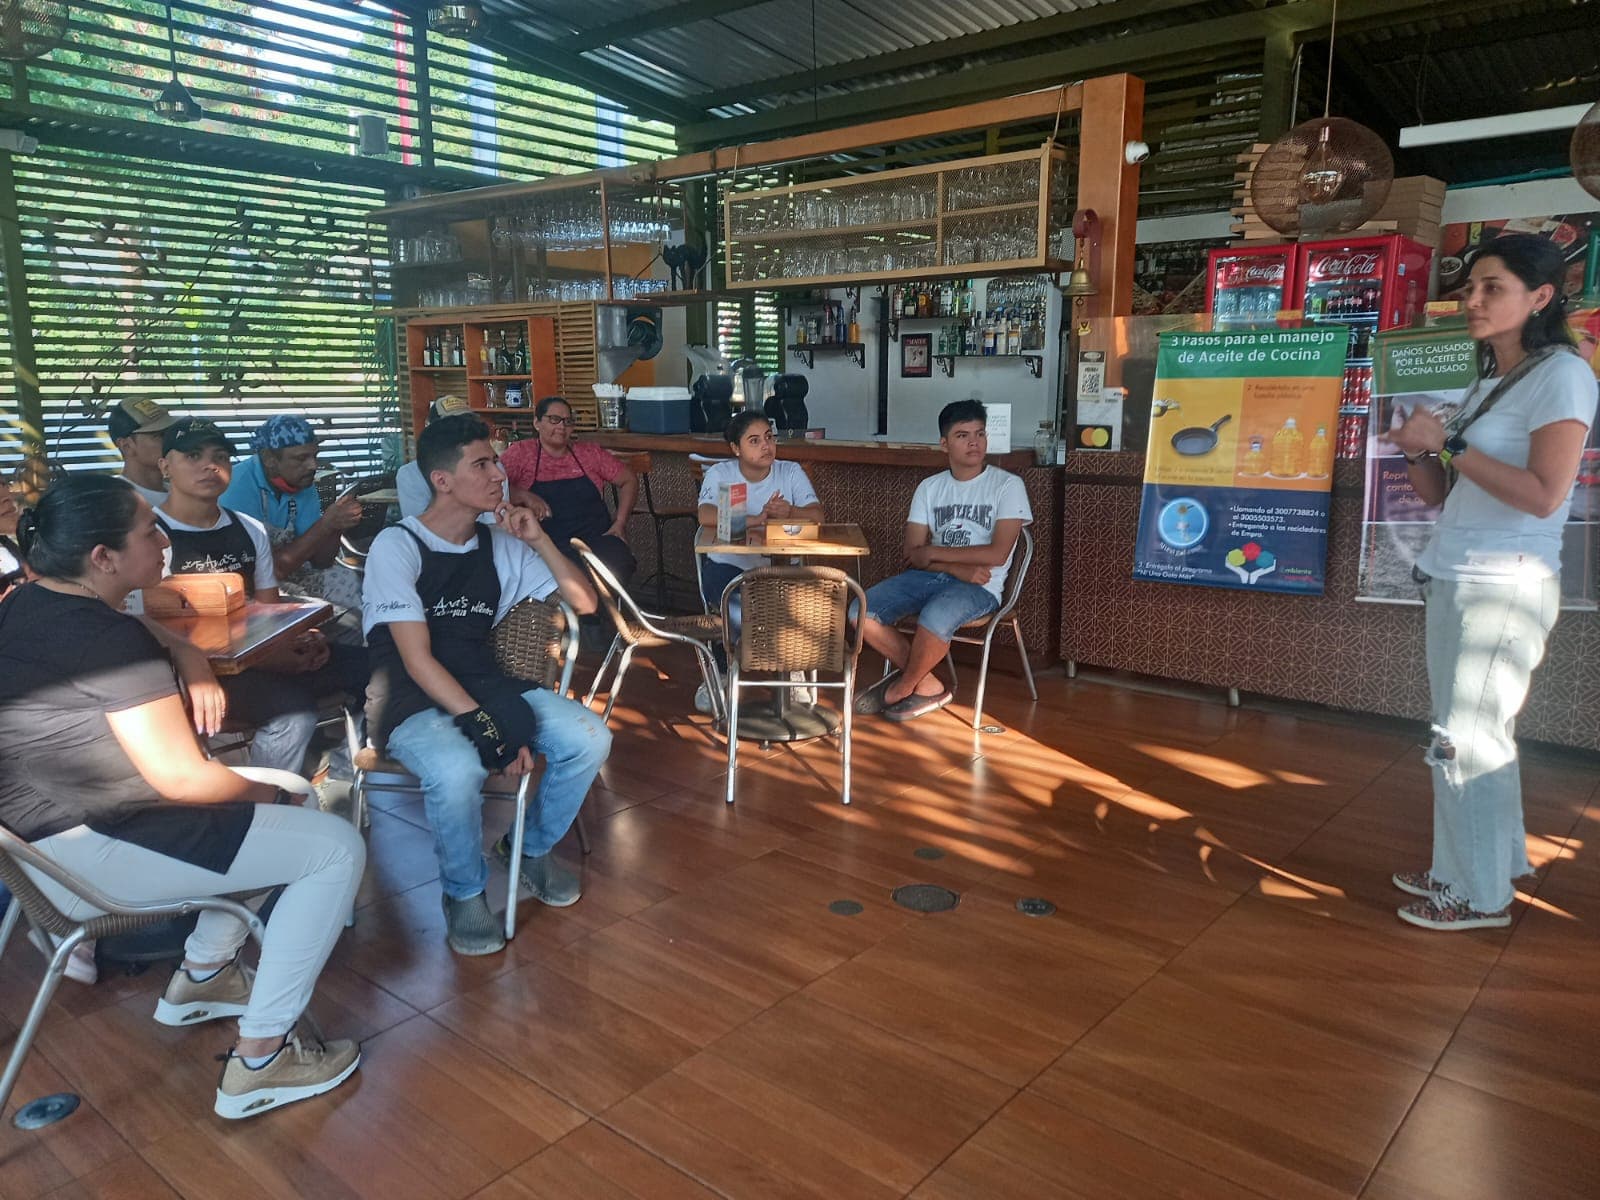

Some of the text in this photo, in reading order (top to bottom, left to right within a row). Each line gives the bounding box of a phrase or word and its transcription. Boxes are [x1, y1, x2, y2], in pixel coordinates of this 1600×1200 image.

[1316, 254, 1380, 277] Coca-Cola
[1171, 331, 1335, 348] 3 Pasos para el manejo
[1178, 347, 1321, 364] de Aceite de Cocina
[1392, 342, 1475, 358] DAÑOS CAUSADOS
[1395, 353, 1471, 367] POR EL ACEITE DE
[1397, 363, 1468, 376] COCINA USADO
